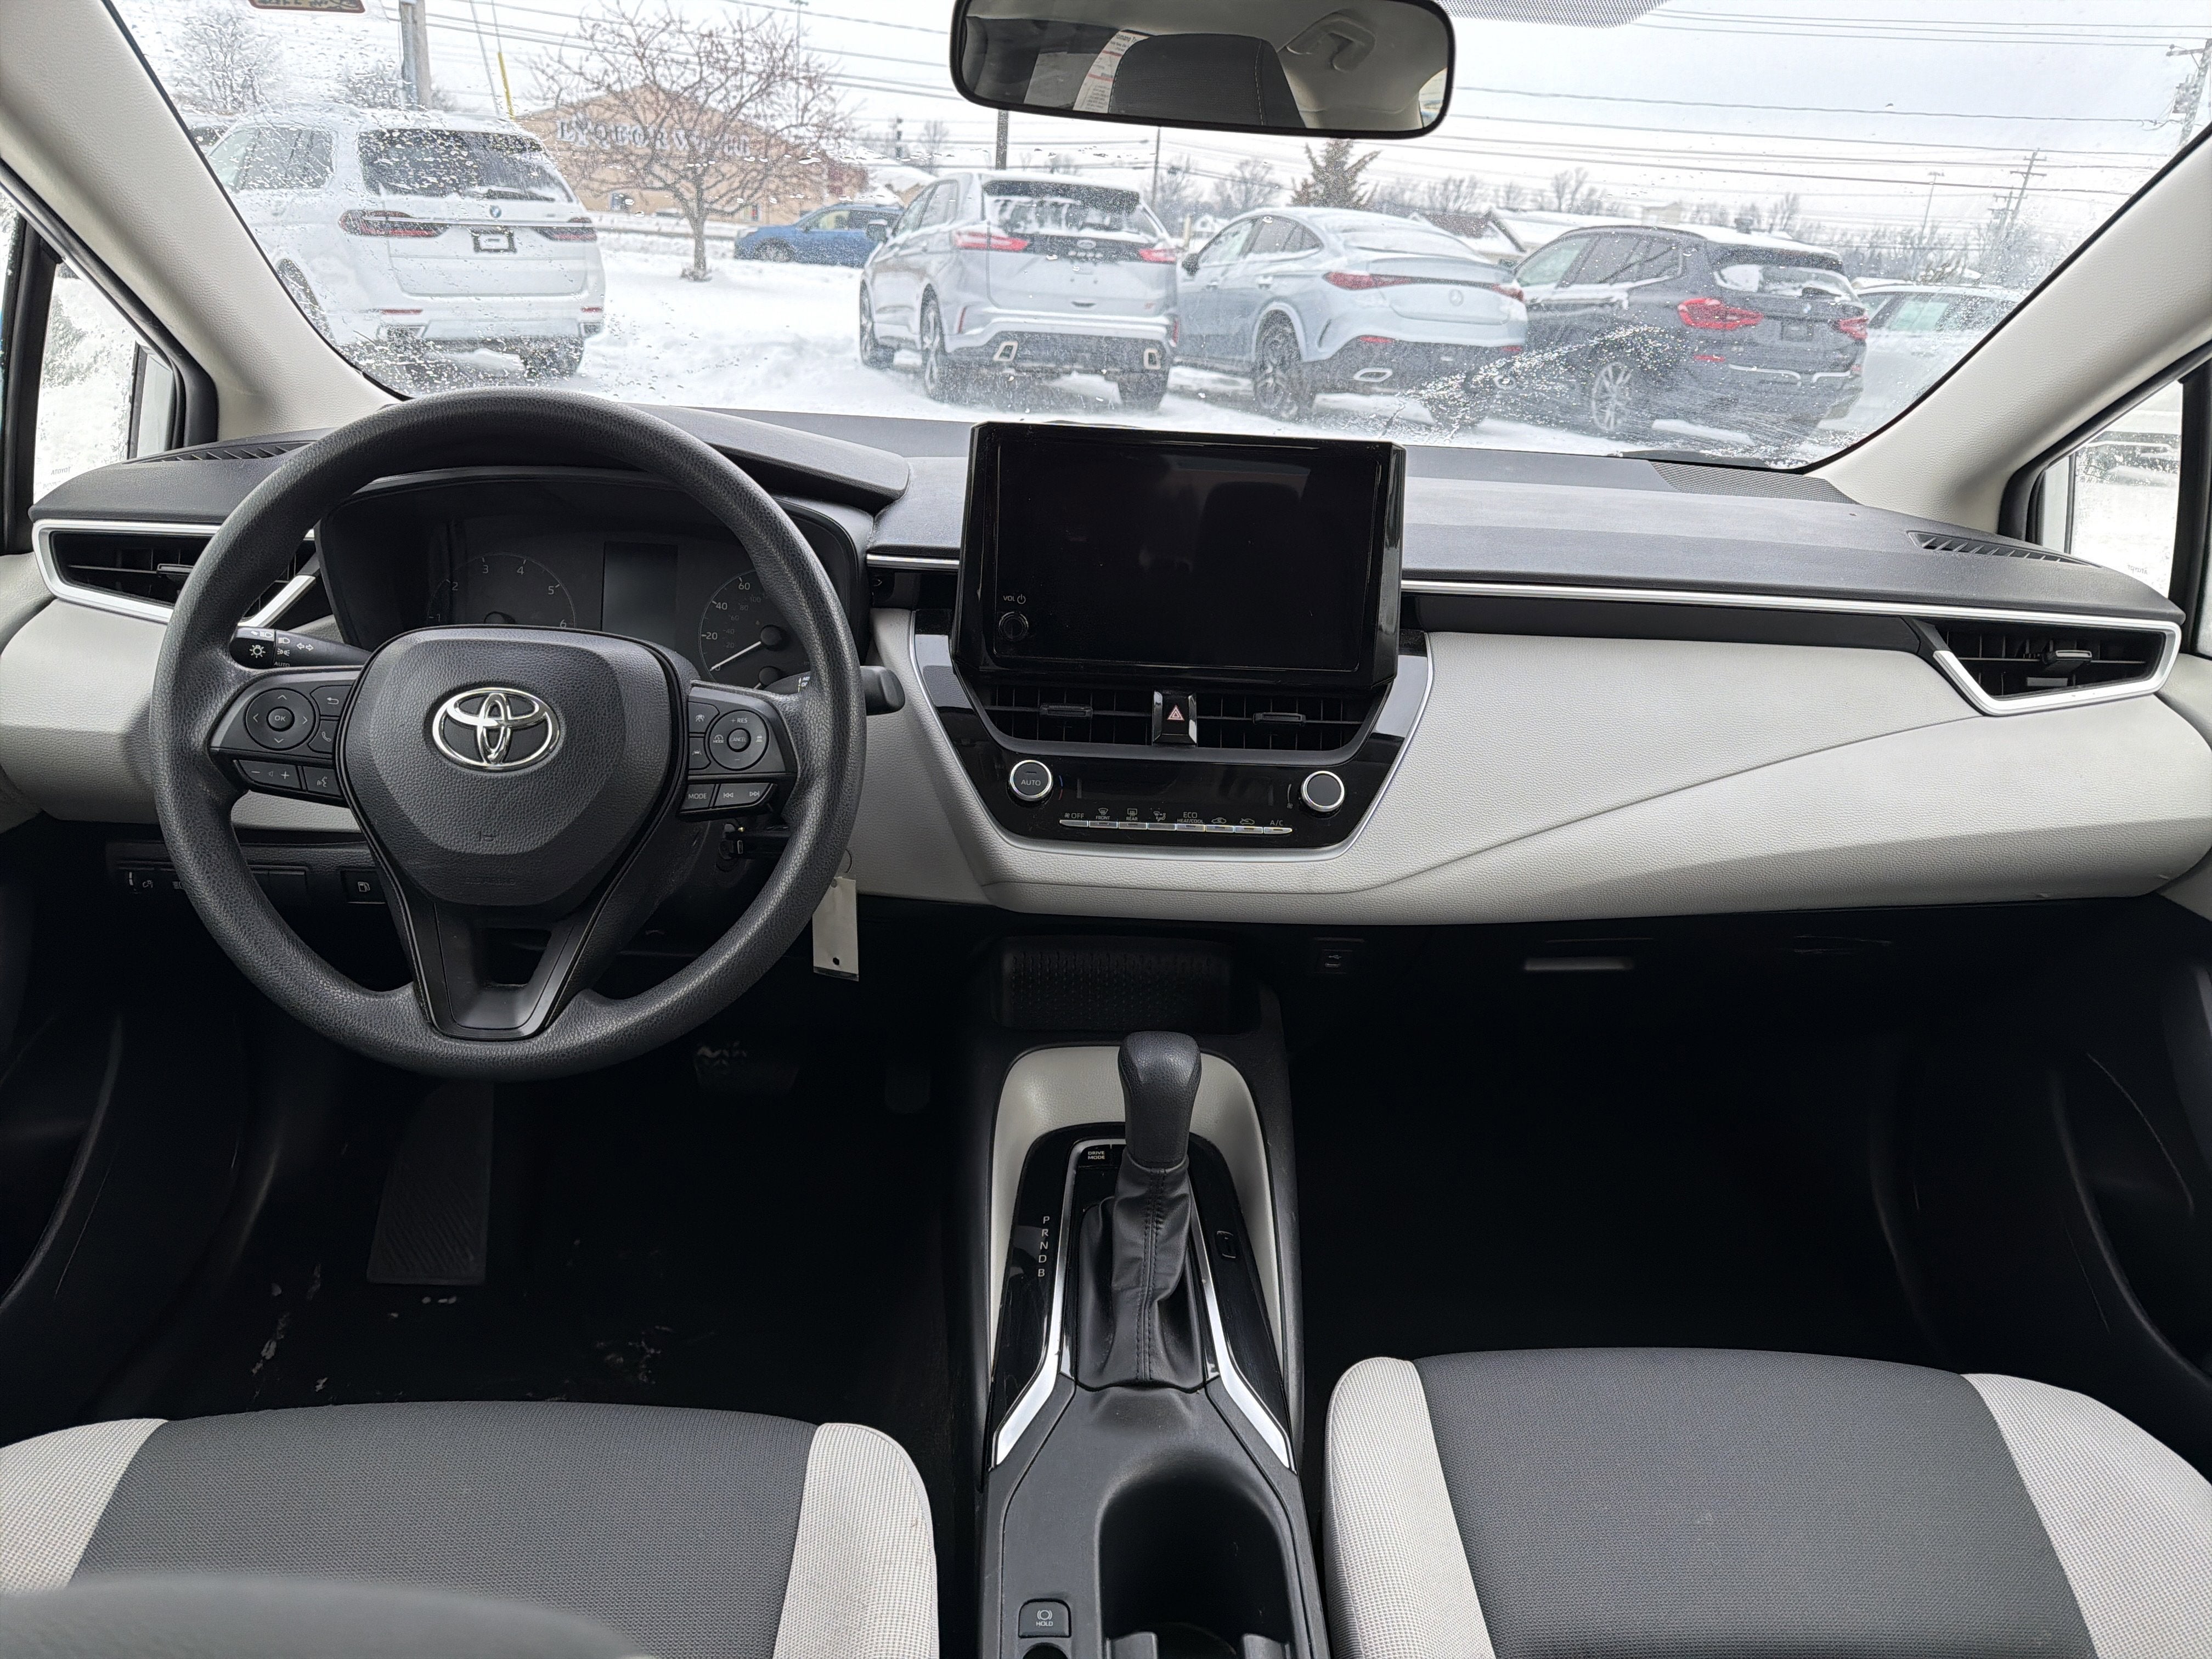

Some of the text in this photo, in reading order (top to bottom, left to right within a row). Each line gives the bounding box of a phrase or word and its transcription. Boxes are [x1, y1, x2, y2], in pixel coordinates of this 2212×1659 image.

[483, 565, 489, 574] 3
[517, 566, 524, 575] 4
[452, 582, 459, 591] 2
[548, 585, 554, 595] 5
[738, 582, 751, 590] 60
[715, 602, 727, 610] 40
[560, 619, 567, 628] 6
[706, 632, 718, 640] 20
[1043, 1216, 1050, 1224] P
[1041, 1228, 1049, 1237] R
[1040, 1241, 1048, 1250] N
[1039, 1255, 1047, 1263] D
[1037, 1268, 1045, 1277] B
